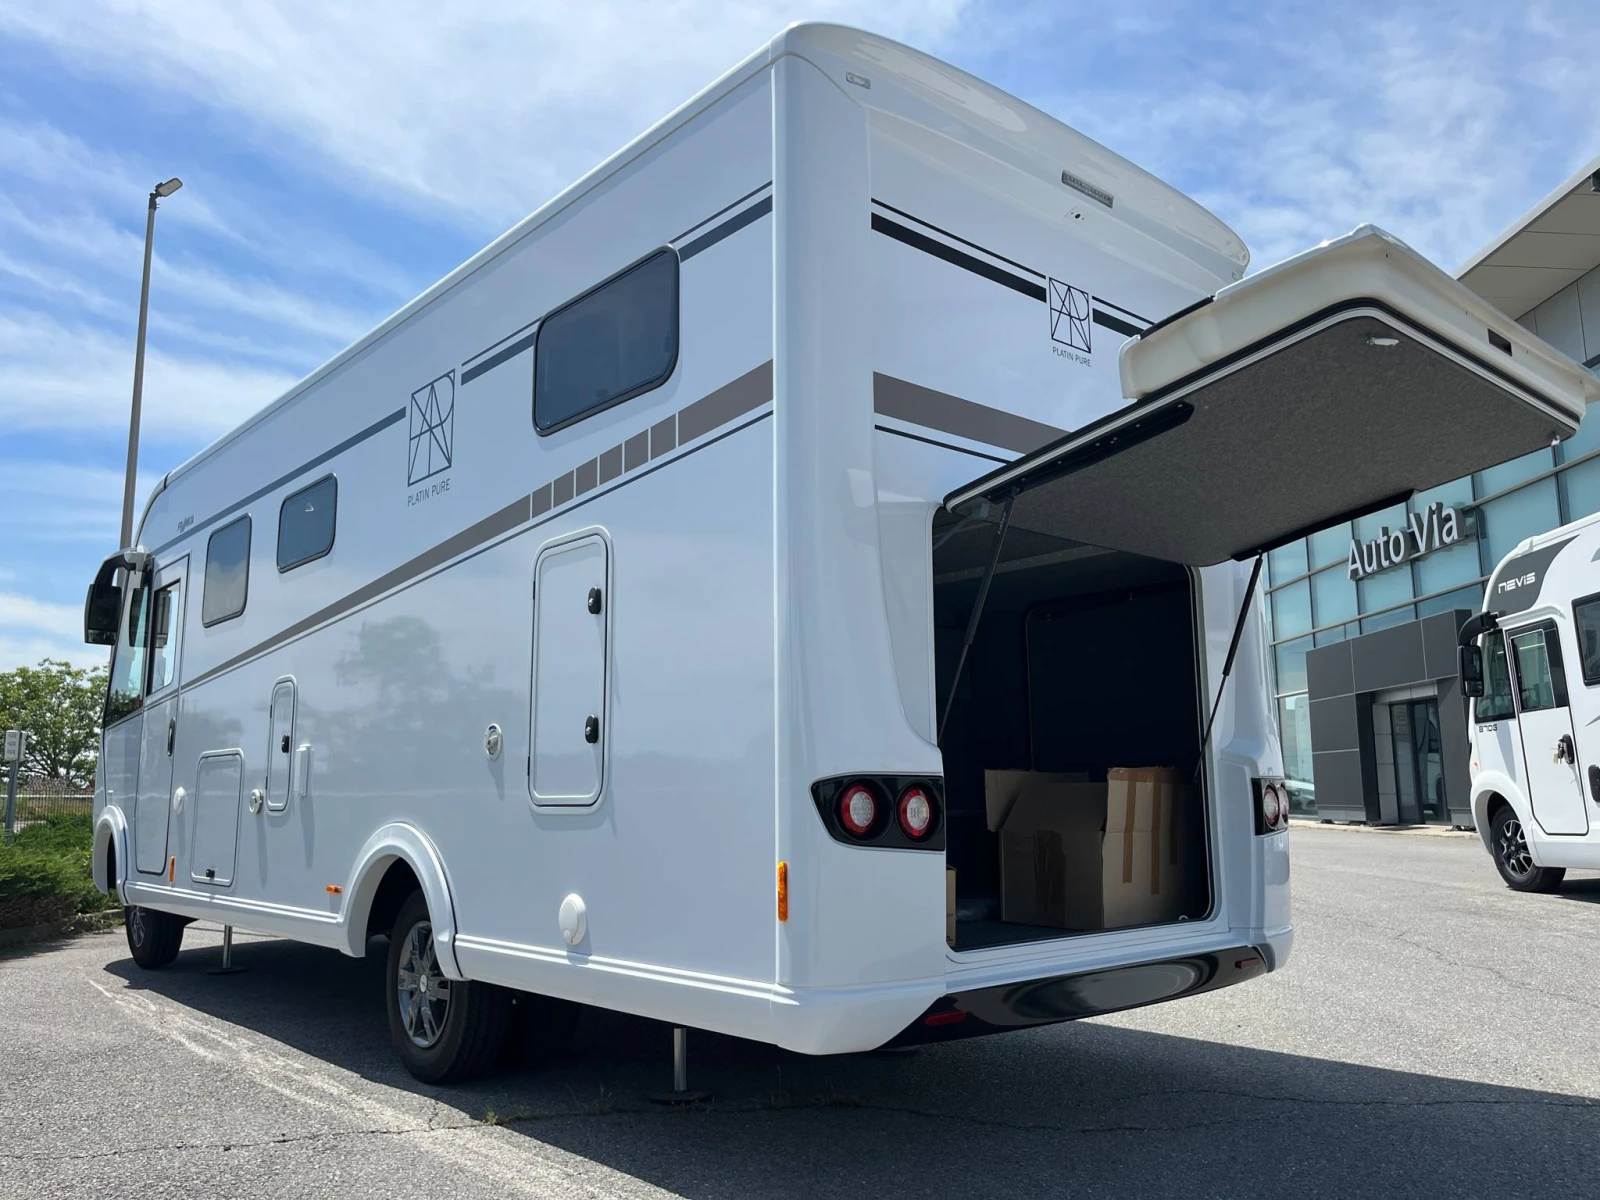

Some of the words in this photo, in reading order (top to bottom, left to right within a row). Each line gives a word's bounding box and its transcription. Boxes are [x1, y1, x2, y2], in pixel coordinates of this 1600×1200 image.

[1052, 346, 1074, 361] PLATIN
[1075, 354, 1091, 367] PURE
[407, 487, 430, 507] PLATIN
[431, 478, 451, 498] PURE
[1347, 526, 1405, 580] Auto
[1409, 501, 1459, 553] Via
